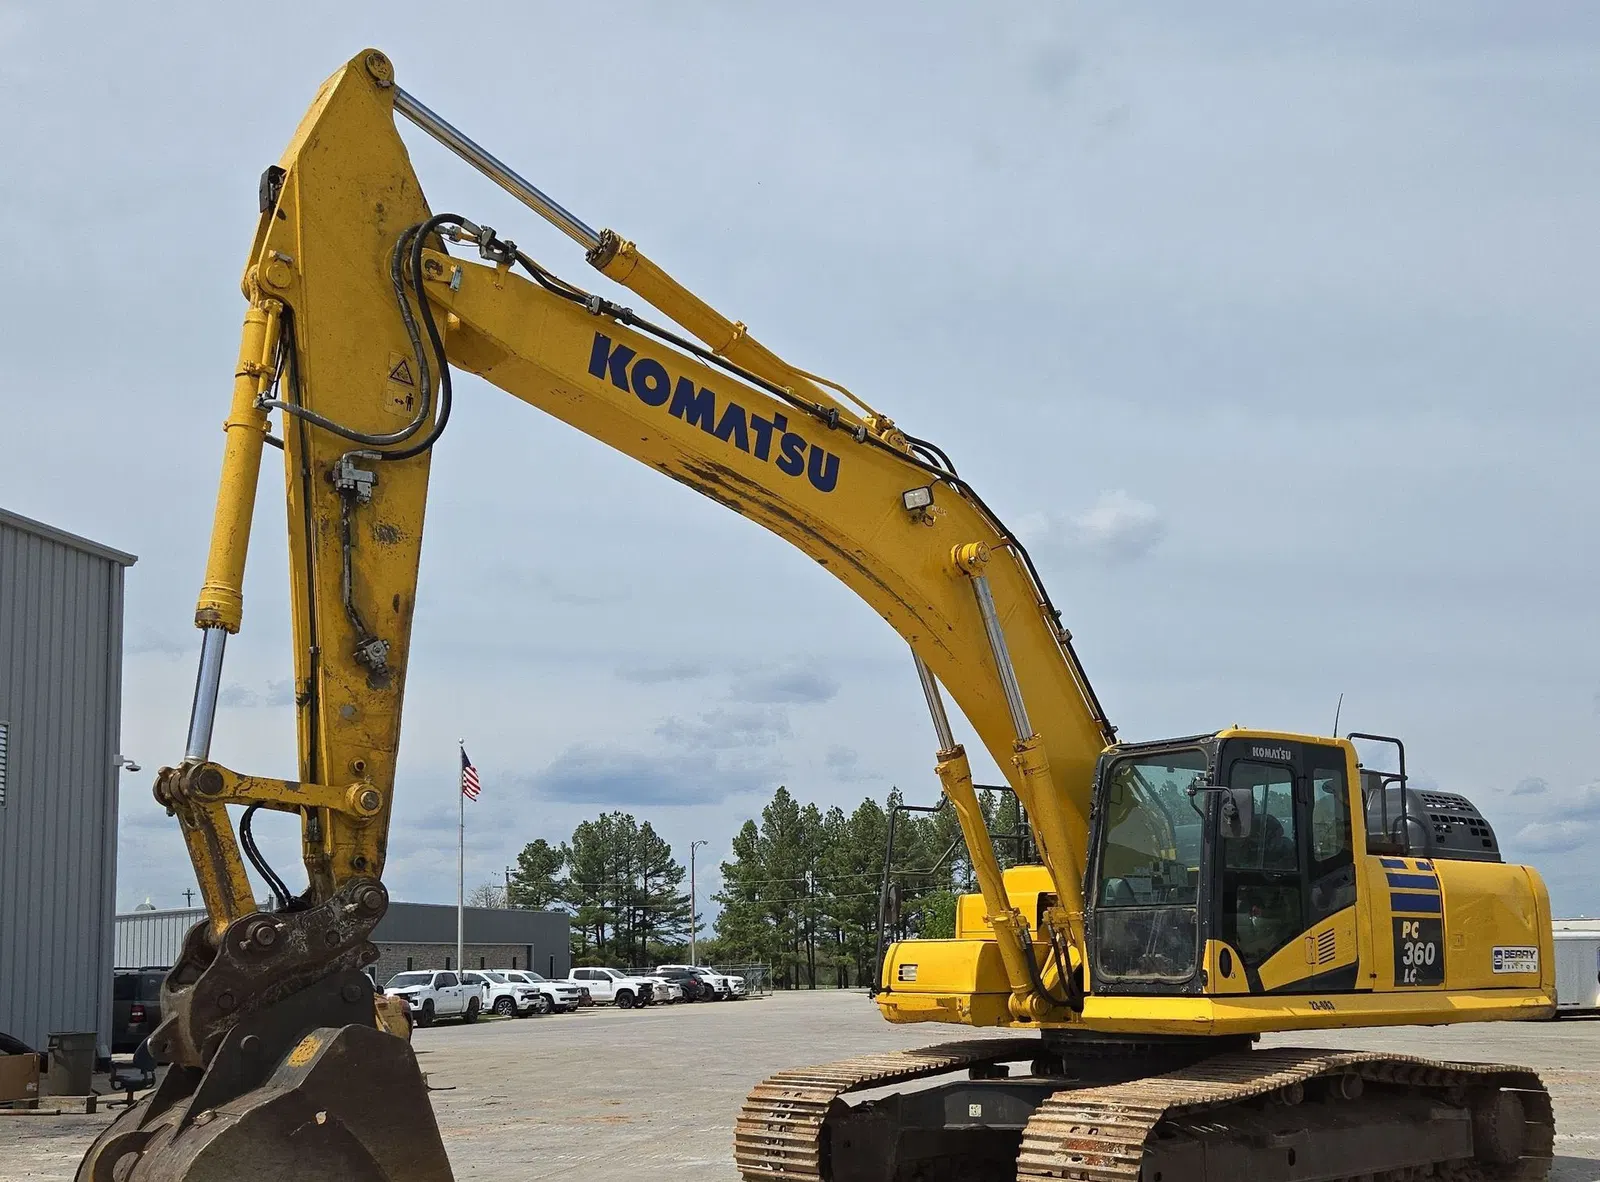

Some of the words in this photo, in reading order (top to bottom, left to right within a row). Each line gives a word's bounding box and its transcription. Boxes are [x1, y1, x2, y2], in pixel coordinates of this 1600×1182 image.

[588, 331, 840, 493] KOMATSU
[1252, 746, 1291, 760] KOMATSU
[1402, 921, 1420, 938] PC
[1402, 942, 1435, 965] 360
[1504, 950, 1536, 959] BERRY
[1403, 969, 1417, 982] LC
